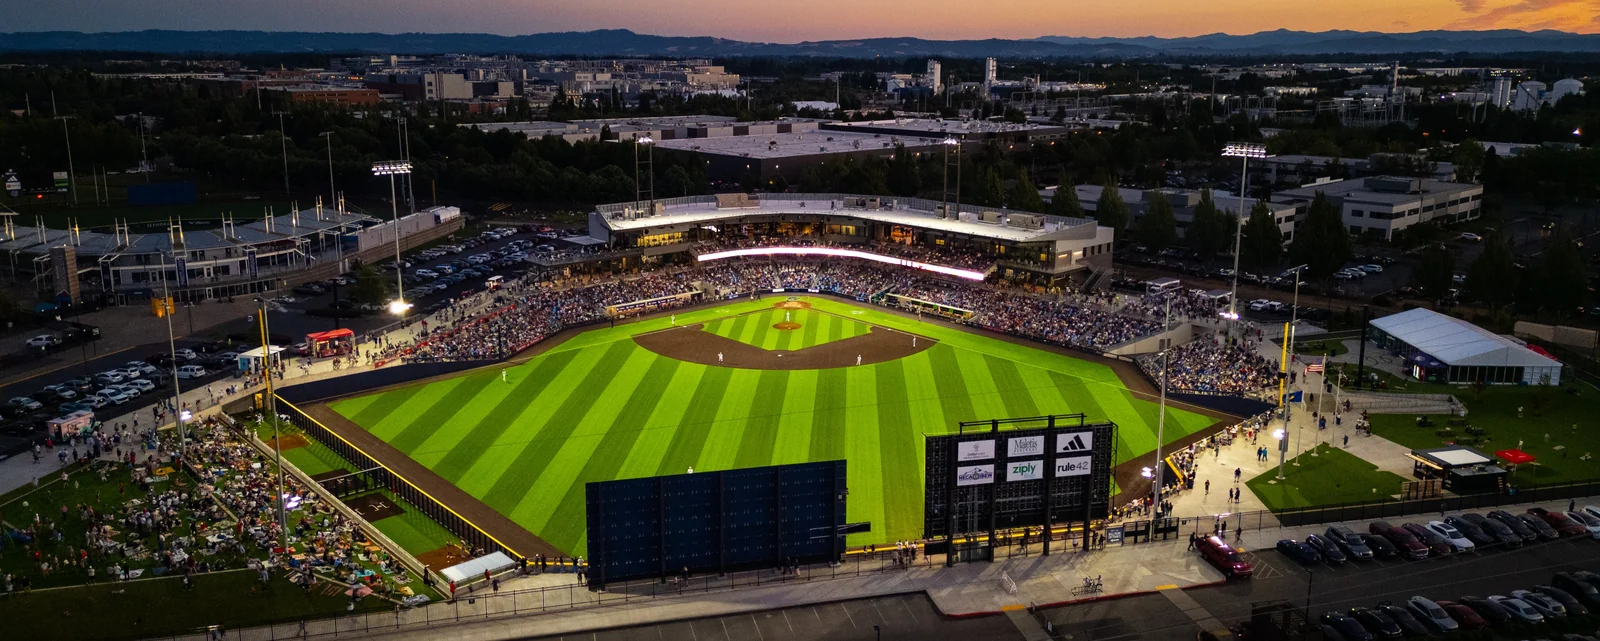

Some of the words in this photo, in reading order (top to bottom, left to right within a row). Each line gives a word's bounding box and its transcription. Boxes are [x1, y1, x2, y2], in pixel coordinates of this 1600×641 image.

[1012, 463, 1036, 475] ziply
[1057, 462, 1075, 472] rule
[1076, 461, 1088, 470] 42
